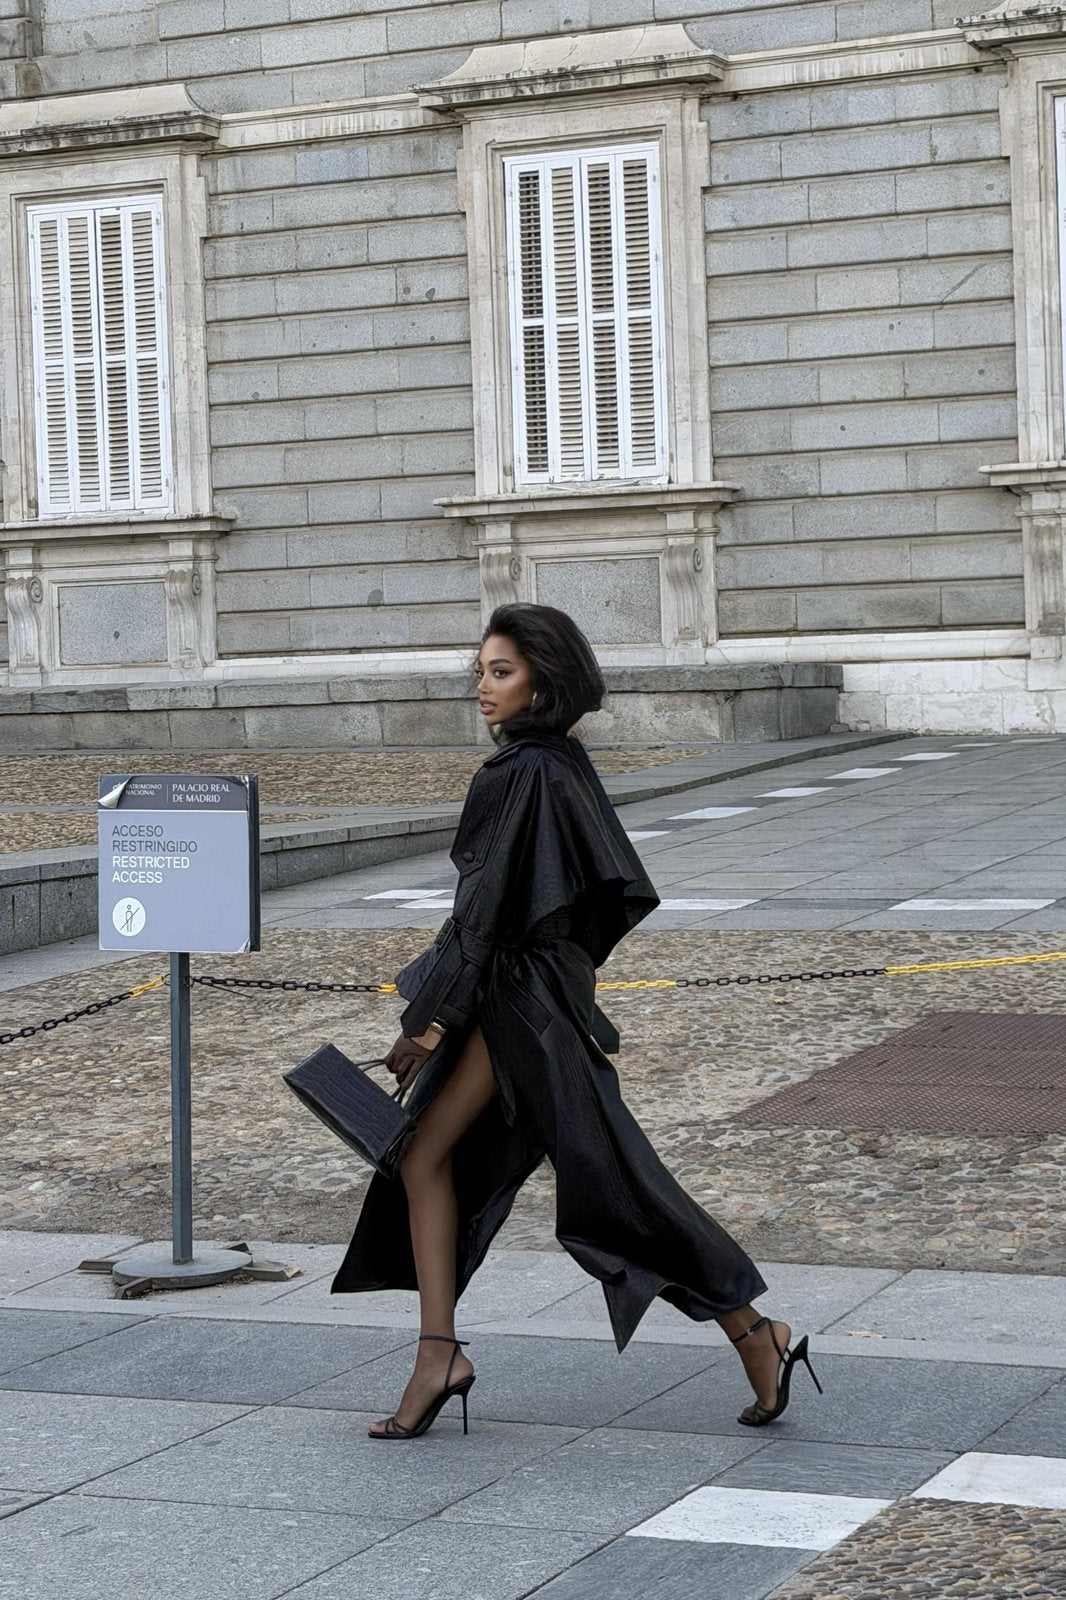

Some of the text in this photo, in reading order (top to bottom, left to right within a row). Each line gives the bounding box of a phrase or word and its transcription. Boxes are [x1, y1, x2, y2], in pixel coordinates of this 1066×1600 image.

[172, 784, 230, 794] PALACIO REAL
[172, 795, 221, 803] DE MADRID
[112, 825, 163, 837] ACCESO
[112, 840, 198, 852] RESTRINGIDO
[112, 856, 190, 869] RESTRICTED
[112, 871, 163, 883] ACCESS
